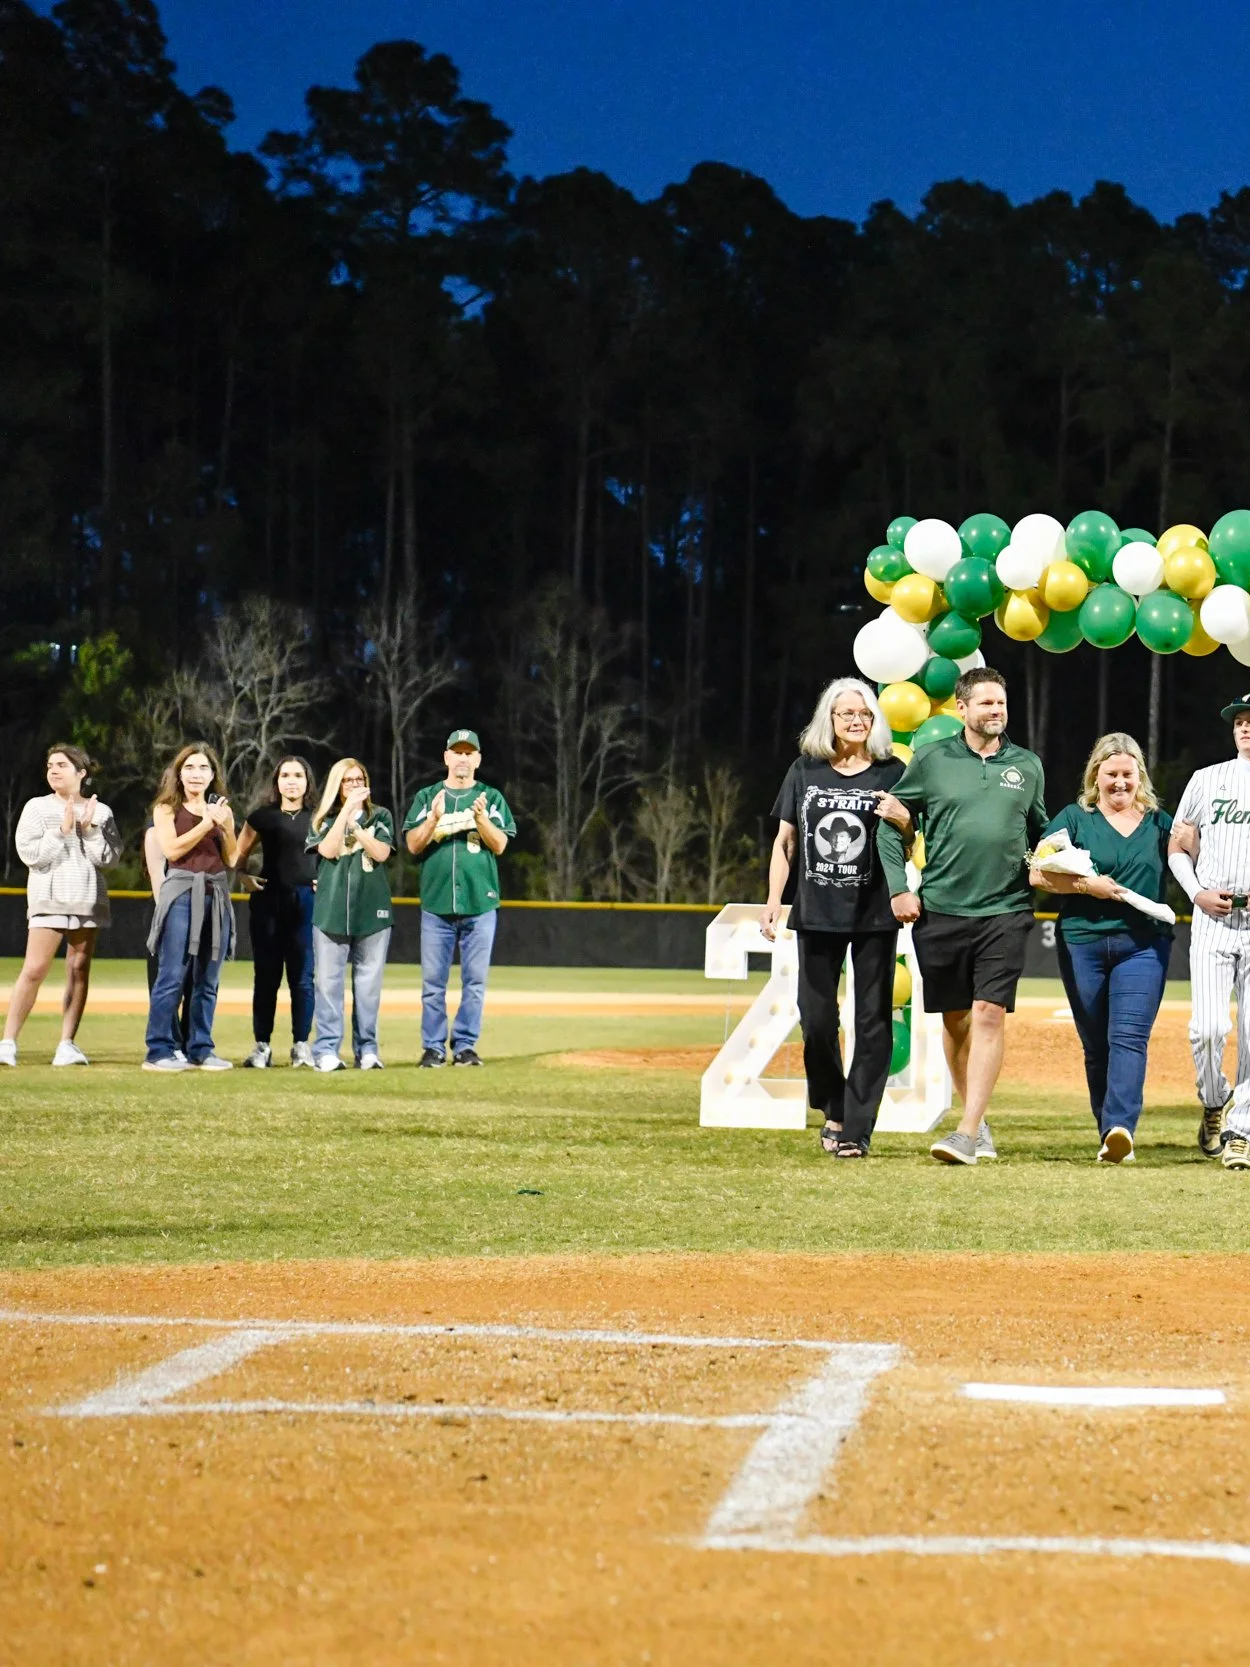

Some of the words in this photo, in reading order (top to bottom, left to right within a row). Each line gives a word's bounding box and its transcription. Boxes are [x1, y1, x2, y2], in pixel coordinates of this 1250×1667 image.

[817, 797, 873, 811] STRAIT
[815, 862, 834, 874] 2024
[837, 864, 858, 875] TOUR
